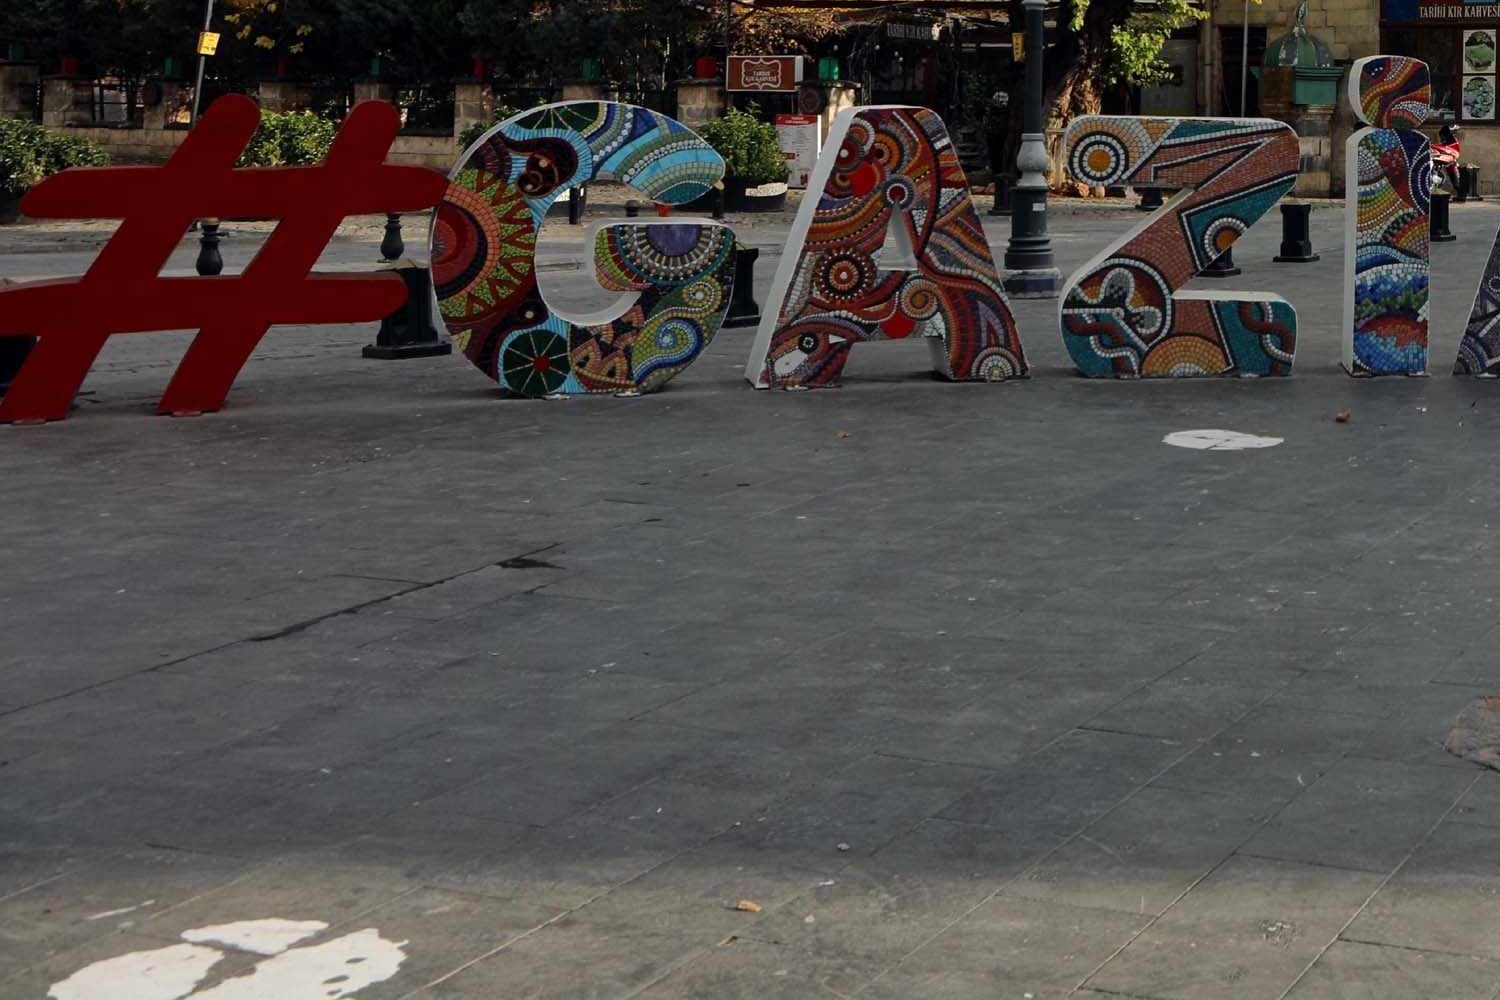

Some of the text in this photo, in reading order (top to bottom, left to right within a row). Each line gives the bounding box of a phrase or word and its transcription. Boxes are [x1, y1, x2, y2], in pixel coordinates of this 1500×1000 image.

[1420, 3, 1500, 18] TARİHİ KIR KAHVESİ
